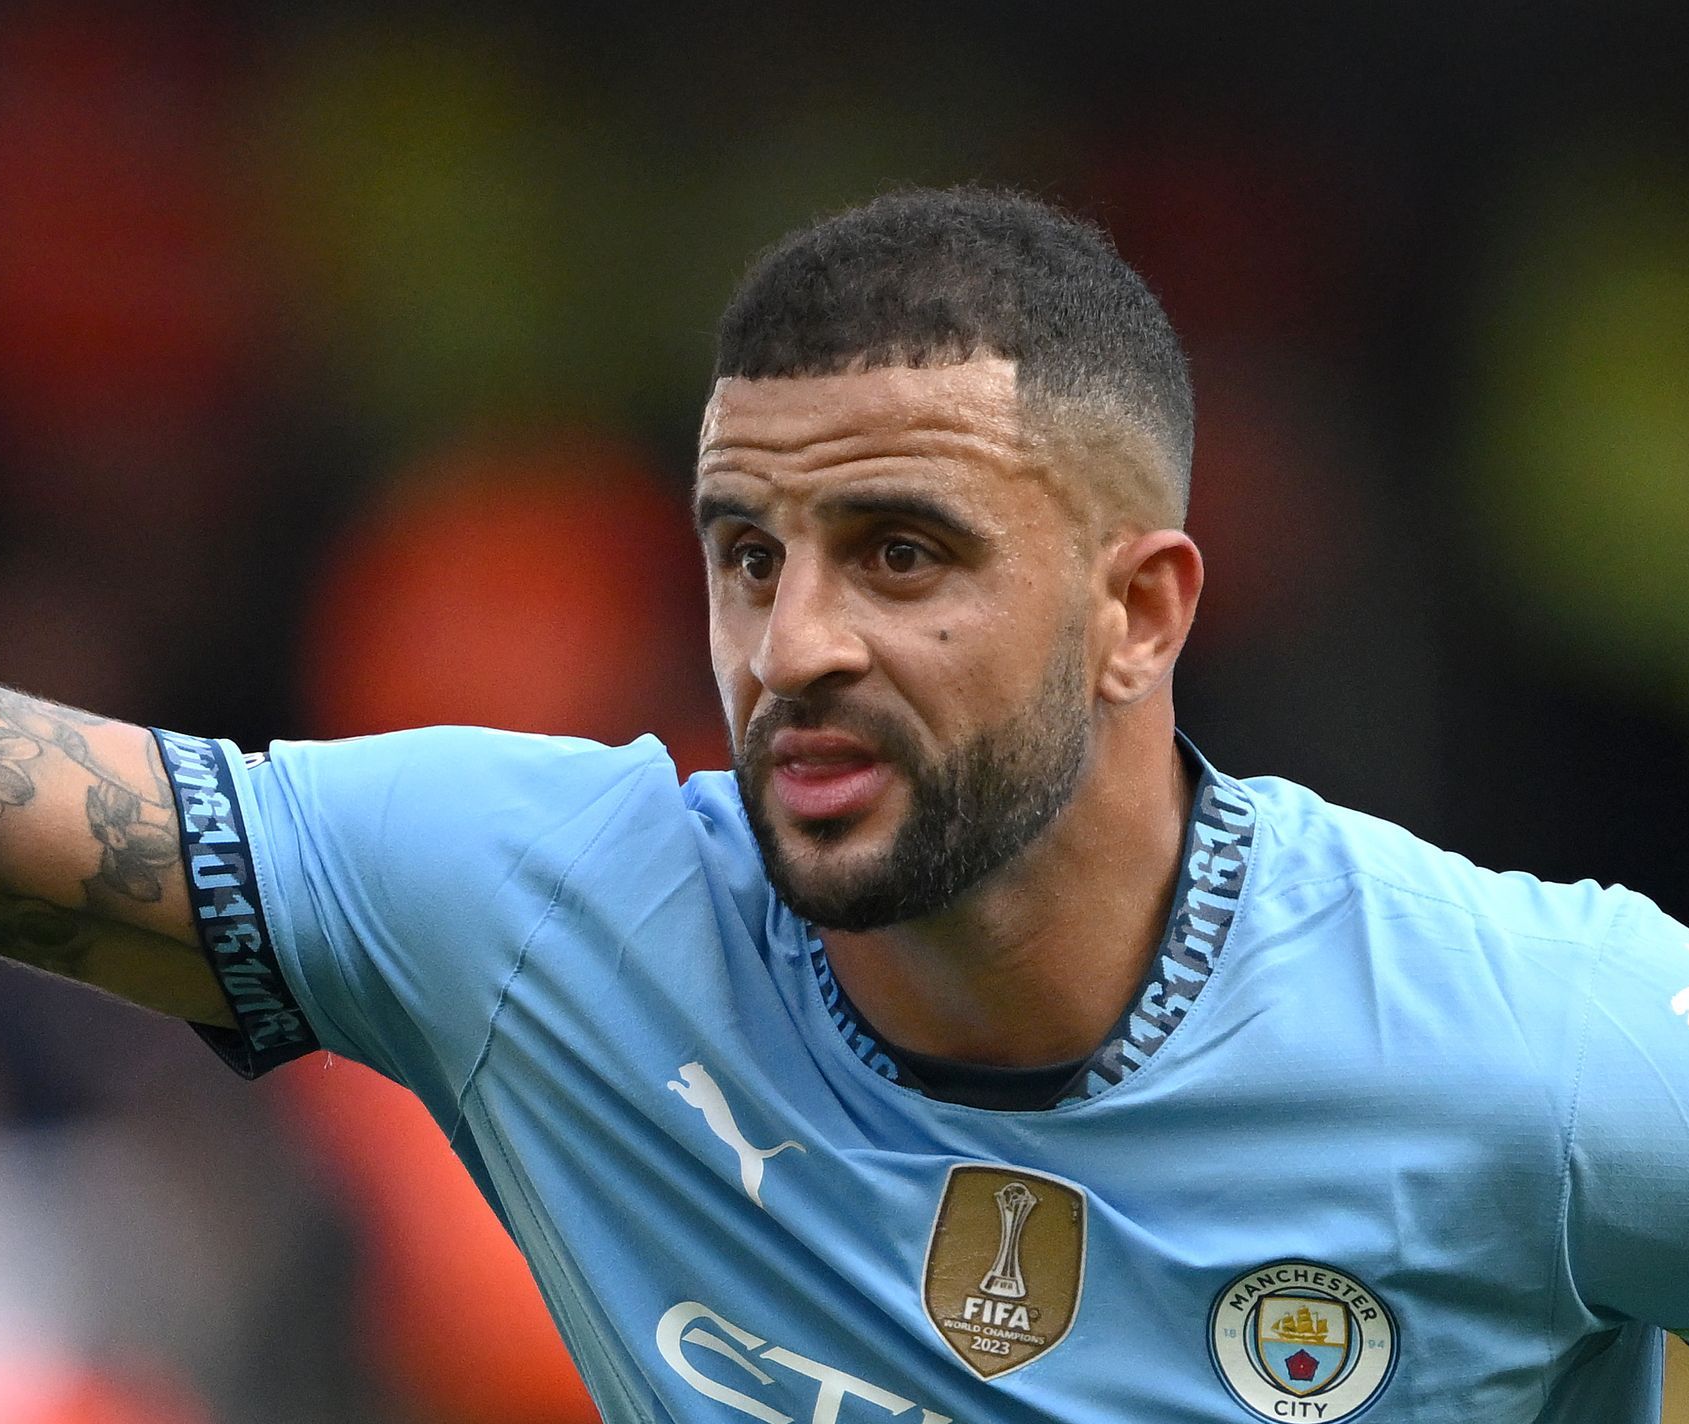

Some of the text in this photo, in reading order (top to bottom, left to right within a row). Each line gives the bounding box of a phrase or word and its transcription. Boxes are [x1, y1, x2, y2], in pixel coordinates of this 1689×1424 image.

[1229, 1269, 1378, 1322] MANCHESTER
[963, 1297, 1031, 1331] FIFA
[943, 1319, 1045, 1345] WORLD CHAMPIONS
[971, 1336, 1011, 1355] 2023
[1274, 1400, 1328, 1419] CITY
